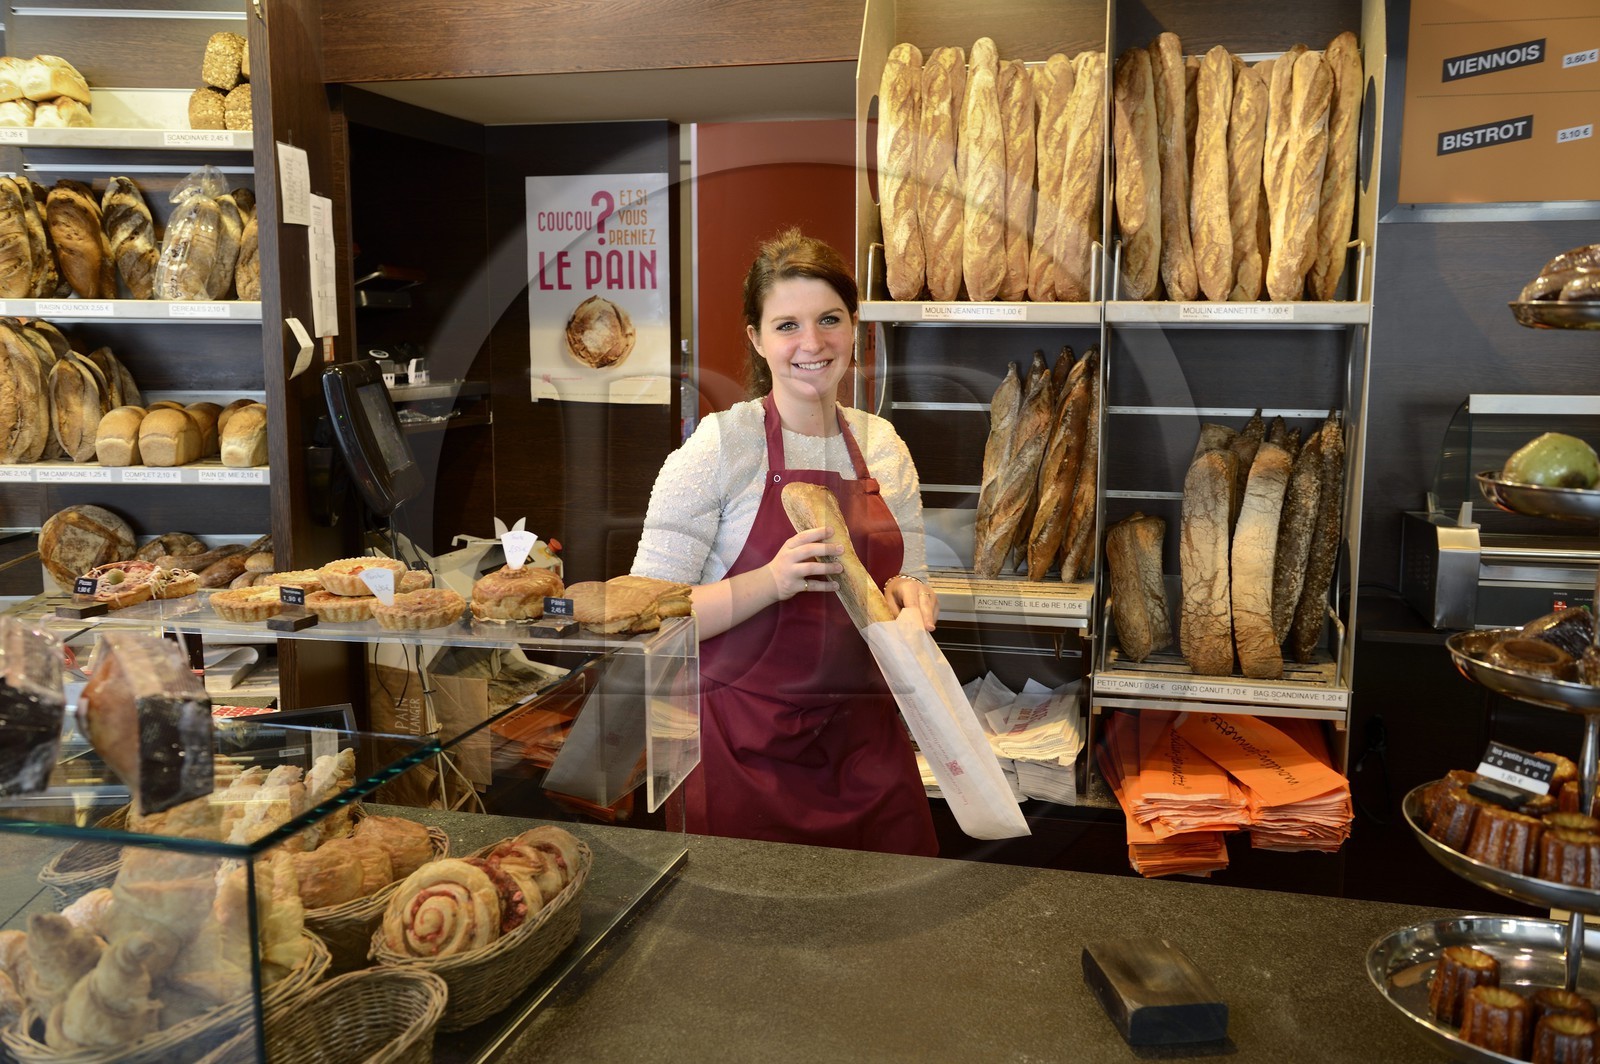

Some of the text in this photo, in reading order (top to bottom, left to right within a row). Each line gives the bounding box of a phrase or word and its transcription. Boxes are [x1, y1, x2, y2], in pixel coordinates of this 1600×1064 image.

[1447, 44, 1540, 77] VIENNOIS
[1566, 51, 1597, 65] 3.60 €
[1442, 121, 1527, 151] BISTROT
[1560, 127, 1590, 140] 3.10 €
[620, 190, 632, 206] ET
[538, 211, 592, 232] COUCOU
[618, 209, 647, 226] VOUS
[609, 228, 656, 246] PRENIEZ
[539, 249, 658, 290] LE PAIN
[1119, 680, 1144, 689] CANUT
[394, 698, 409, 730] PAIN
[1492, 746, 1502, 756] les
[1502, 751, 1523, 762] petits
